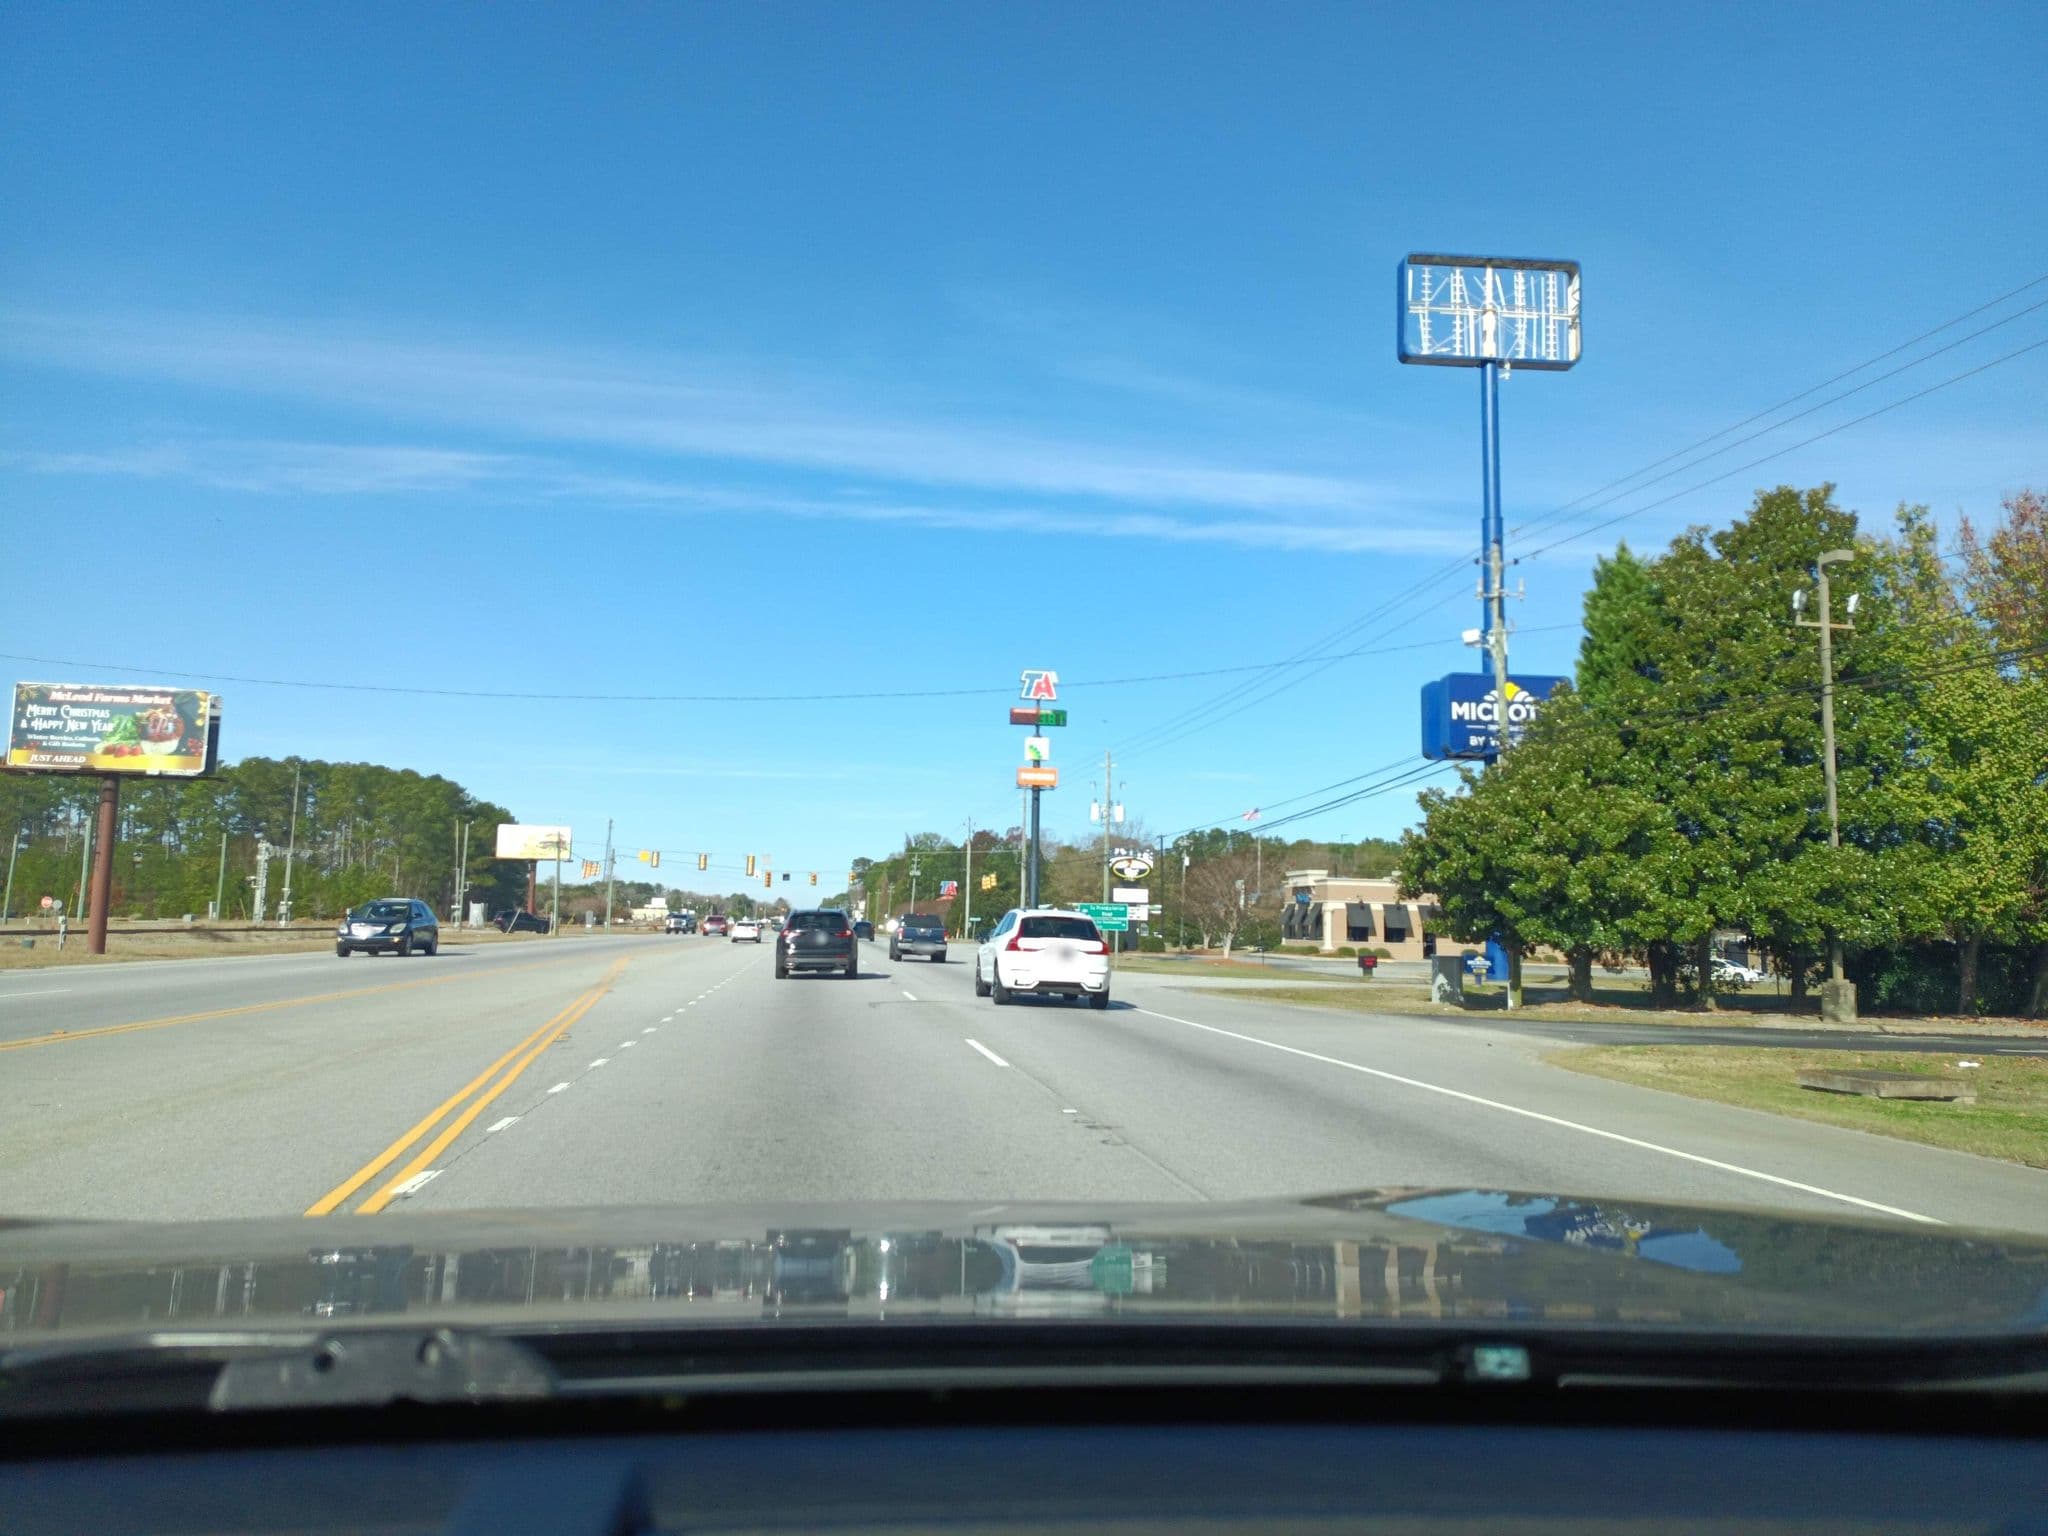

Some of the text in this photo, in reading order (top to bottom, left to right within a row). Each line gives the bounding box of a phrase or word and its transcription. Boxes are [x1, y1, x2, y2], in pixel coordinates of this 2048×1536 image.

[1021, 671, 1058, 700] TA
[95, 693, 131, 704] Farms
[20, 719, 28, 729] &
[31, 718, 64, 731] HAPPY
[1469, 736, 1486, 746] BY
[30, 754, 86, 763] JUST AHEAD
